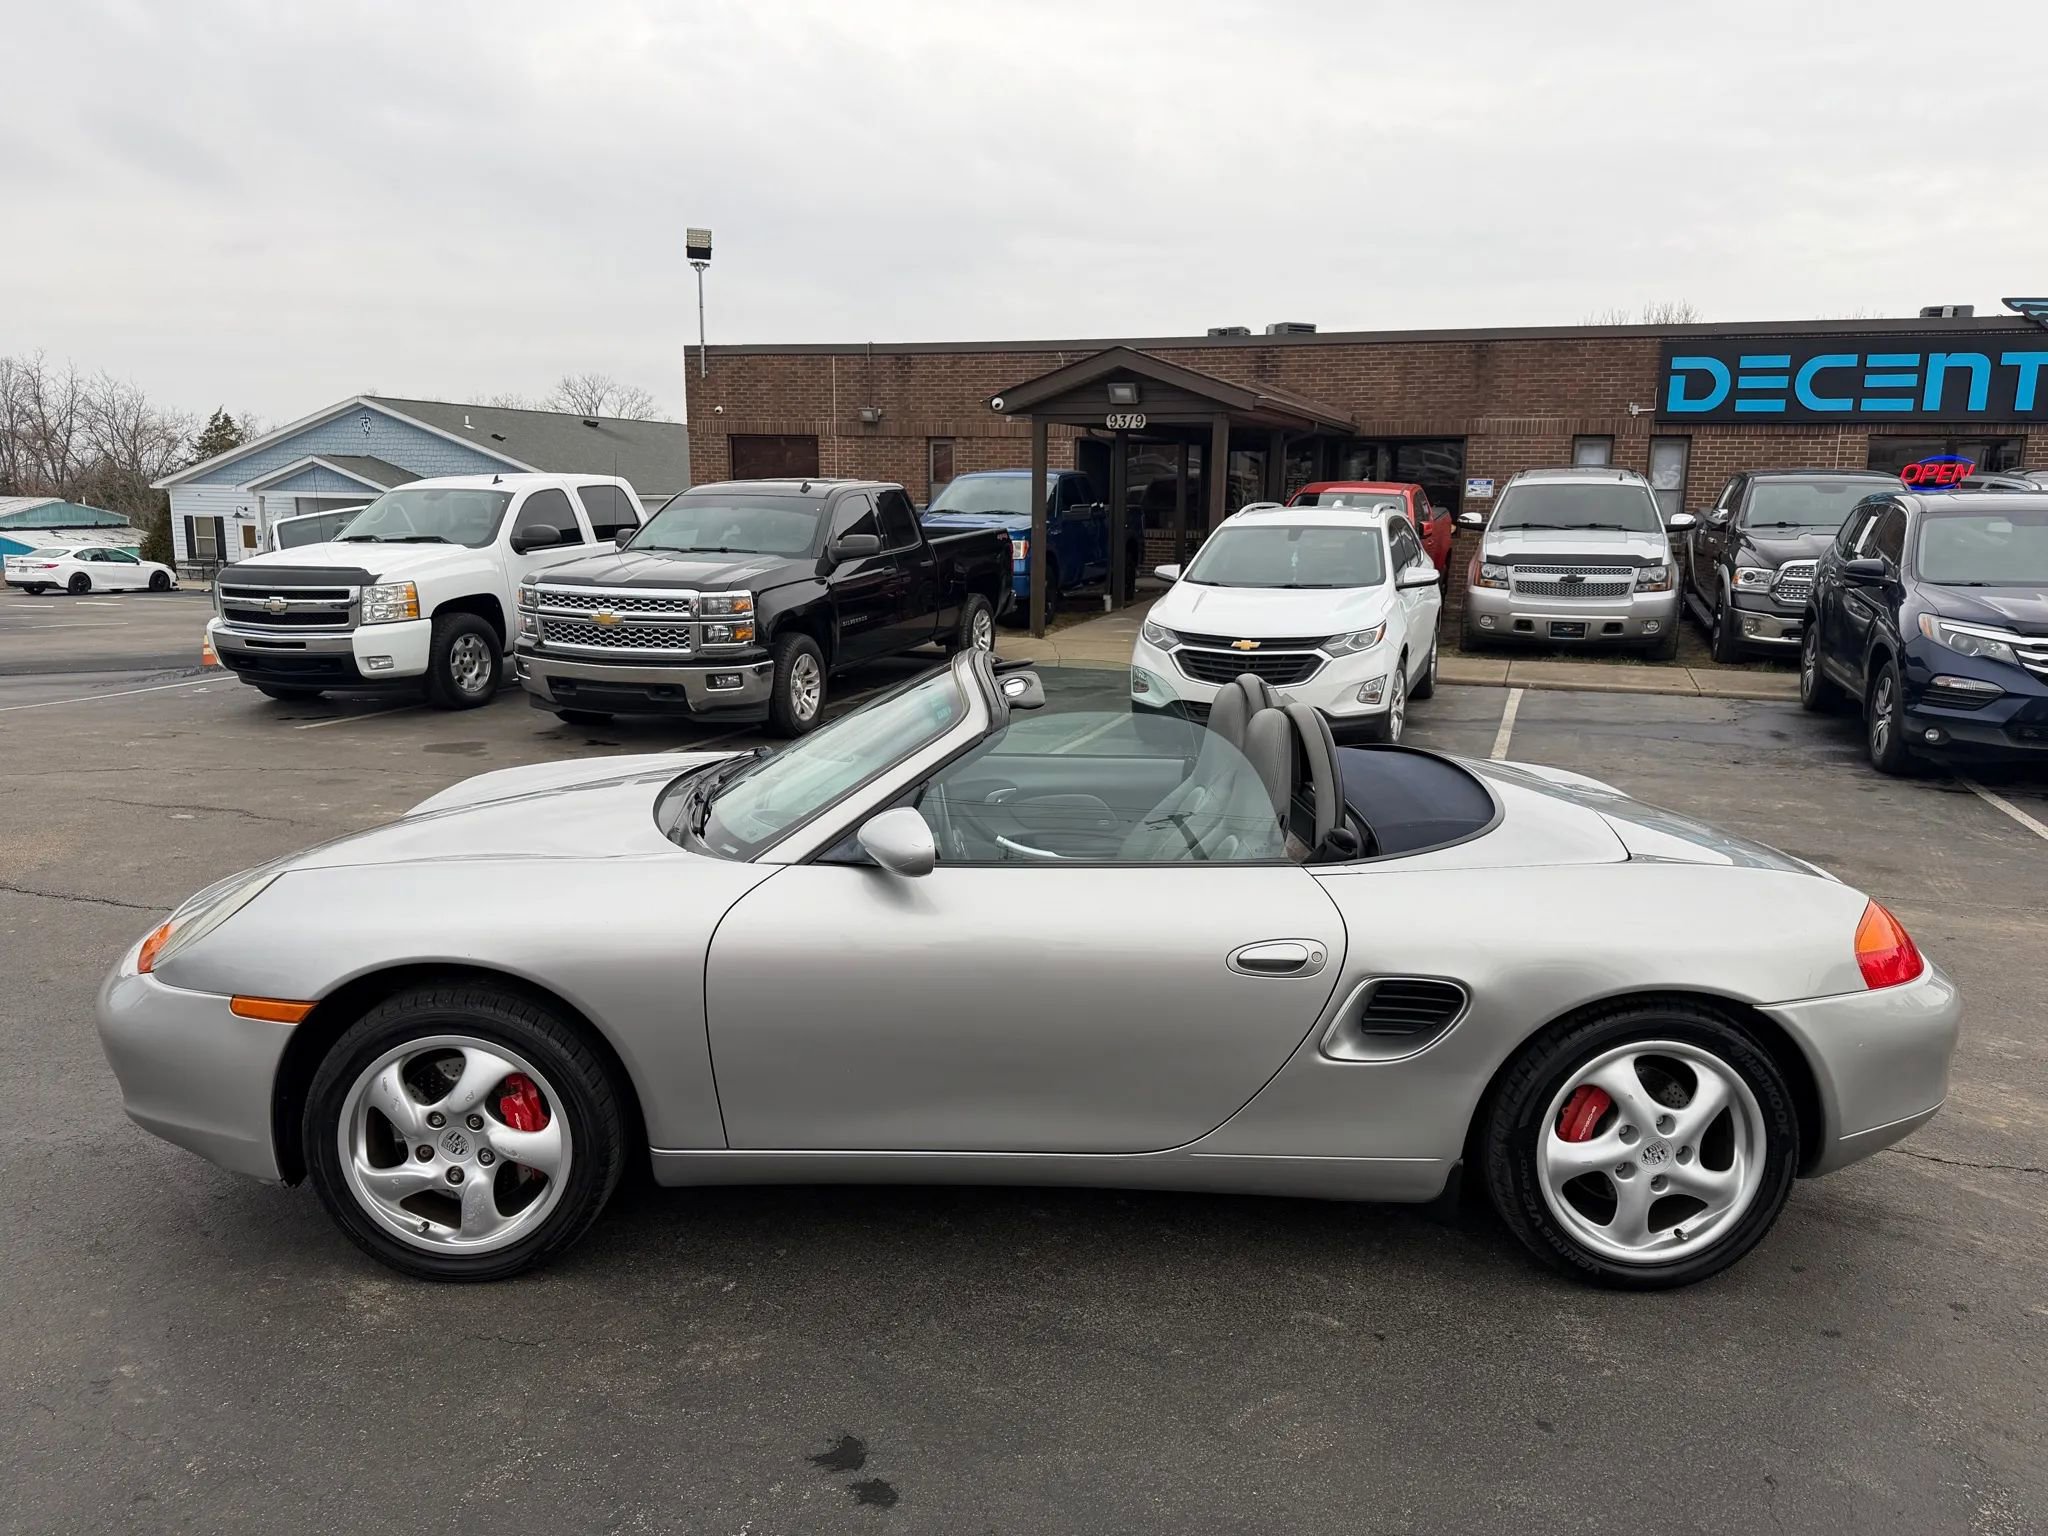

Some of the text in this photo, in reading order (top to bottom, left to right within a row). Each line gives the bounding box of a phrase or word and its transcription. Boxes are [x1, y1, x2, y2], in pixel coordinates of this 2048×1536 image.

[1667, 352, 2048, 412] DECENT
[1109, 414, 1144, 428] 9319
[1900, 463, 1976, 484] OPEN
[1579, 1105, 1597, 1140] PORSCHE
